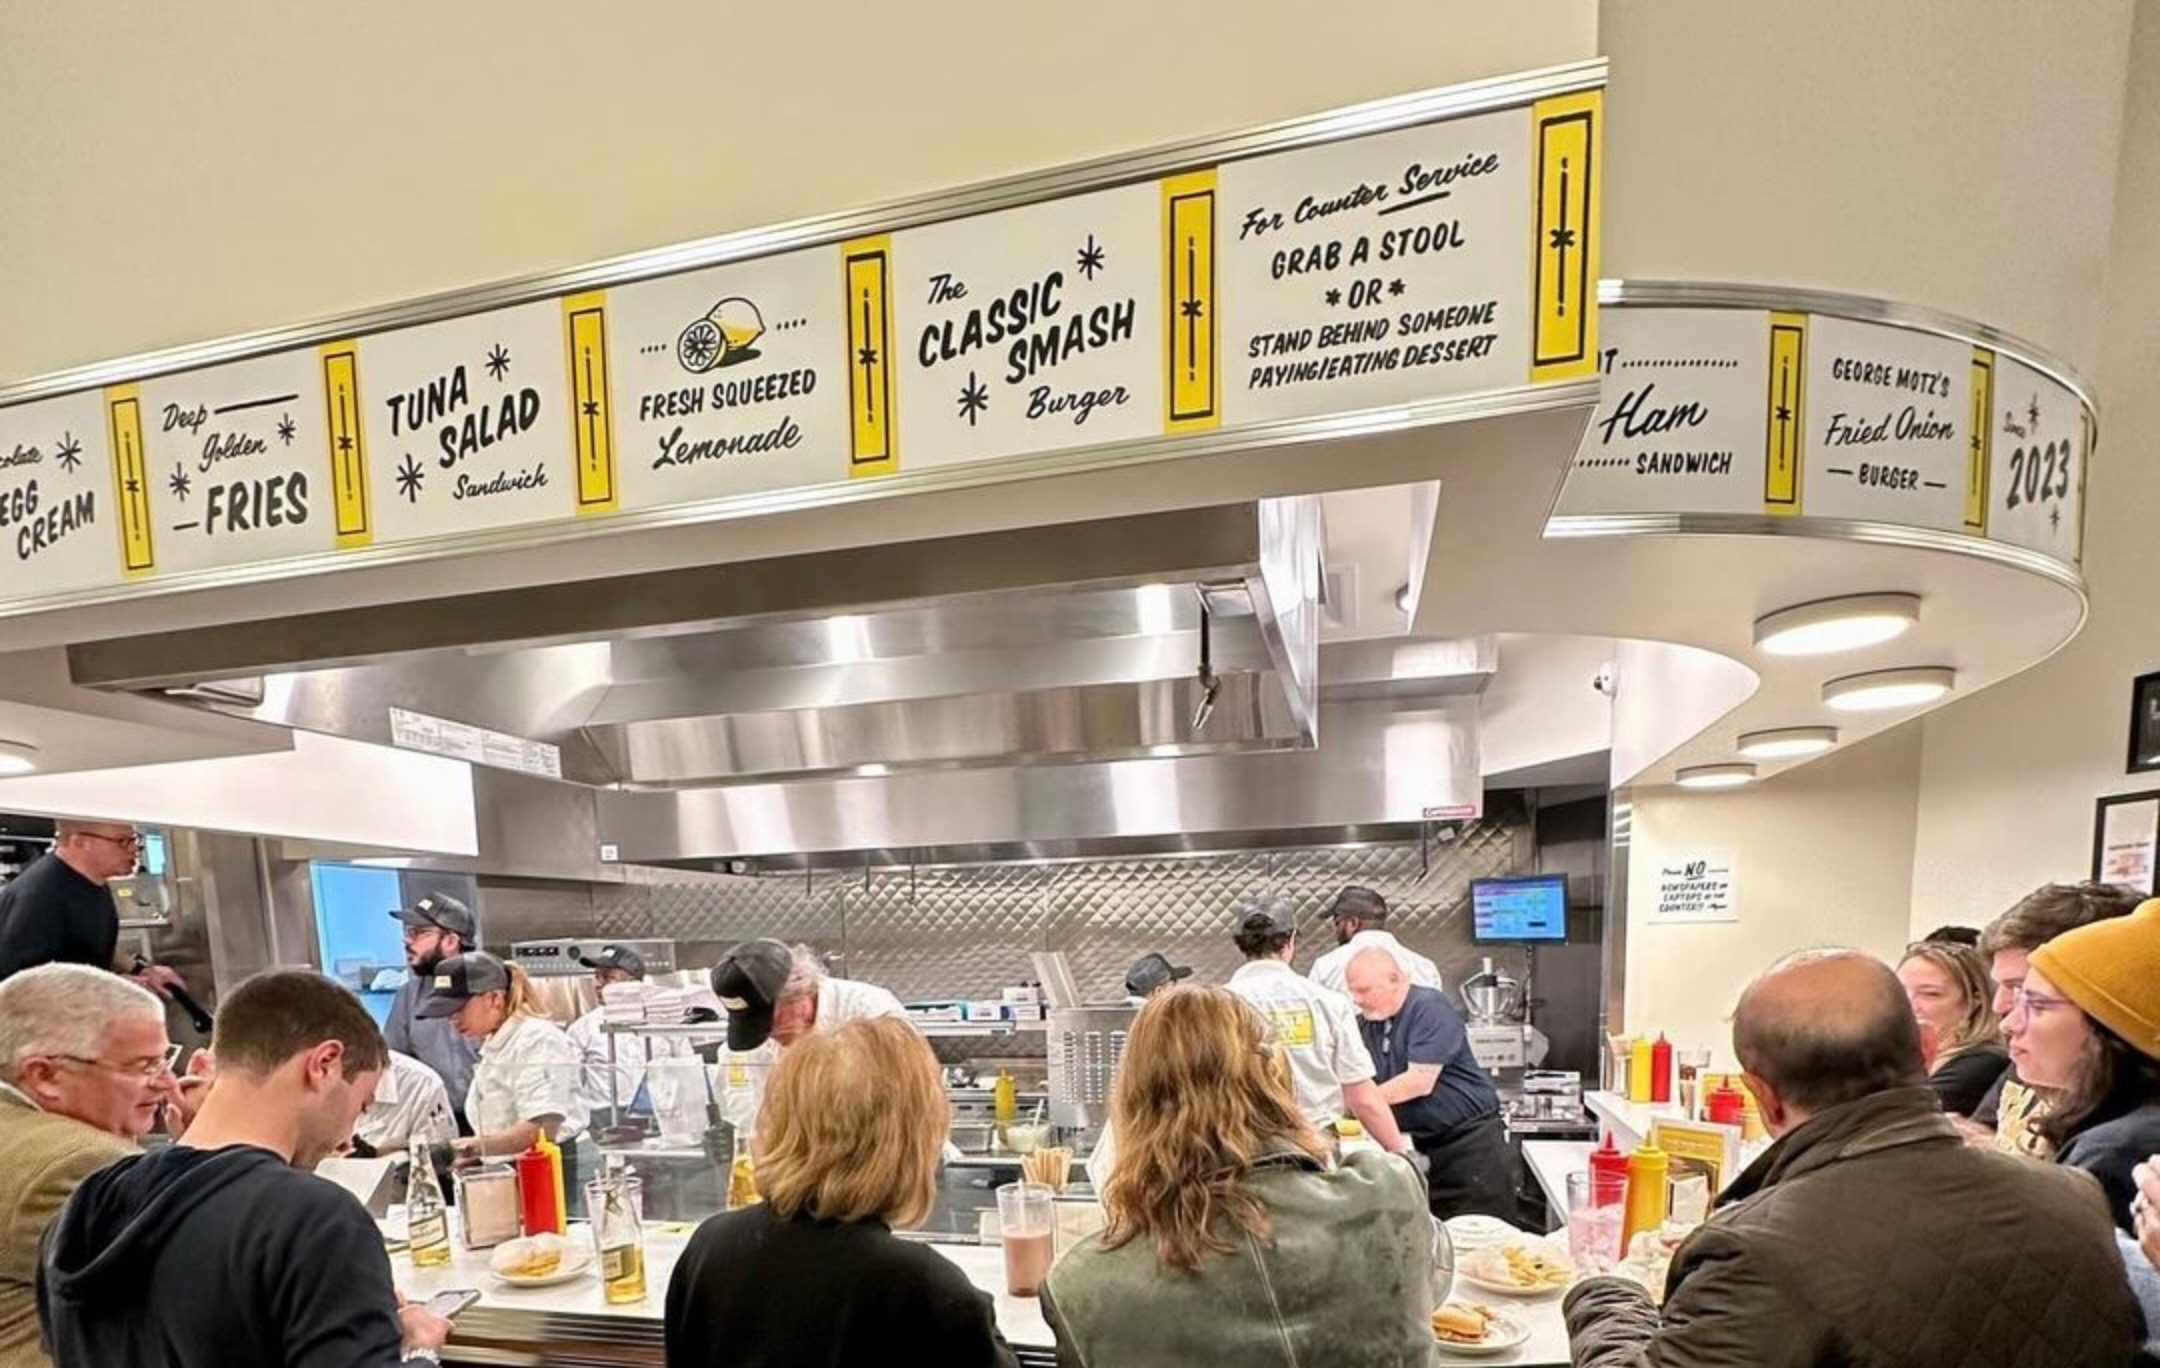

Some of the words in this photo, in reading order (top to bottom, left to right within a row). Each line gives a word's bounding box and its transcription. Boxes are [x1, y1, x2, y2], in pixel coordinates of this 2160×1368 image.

[1240, 208, 1284, 241] For
[1294, 184, 1388, 225] Counter
[1398, 153, 1499, 196] Service
[1272, 241, 1342, 280] GRAB
[1349, 236, 1369, 266] A
[1379, 220, 1465, 261] STOOL
[928, 274, 968, 305] The
[1348, 278, 1382, 309] OR
[918, 271, 1064, 368] CLASSIC
[1005, 298, 1135, 384] SMASH
[1248, 329, 1312, 359] STAND
[1318, 318, 1390, 349] BEHIND
[1398, 301, 1498, 336] SOMEONE
[1249, 348, 1400, 390] PAYING/EATING
[1402, 334, 1498, 368] DESSERT
[1598, 348, 1619, 375] T
[1832, 357, 1893, 387] GEORGE
[1895, 367, 1950, 398] MOTZ'S
[163, 403, 207, 436] Deep
[386, 365, 468, 436] TUNA
[640, 387, 704, 422] FRESH
[712, 369, 816, 411] SQUEEZED
[1026, 386, 1130, 425] Burger
[1599, 383, 1709, 445] Ham
[439, 388, 540, 469] SALAD
[652, 416, 802, 470] Lemonade
[1824, 412, 1891, 446] Fried
[1894, 405, 1955, 441] Onion
[453, 462, 548, 500] Sandwich
[1636, 452, 1733, 475] SANDWICH
[1858, 463, 1919, 491] BURGER
[2006, 439, 2069, 509] 2023
[0, 480, 38, 526] EGG
[18, 491, 94, 560] CREAM
[206, 472, 307, 535] FRIES
[1684, 860, 1706, 877] NO
